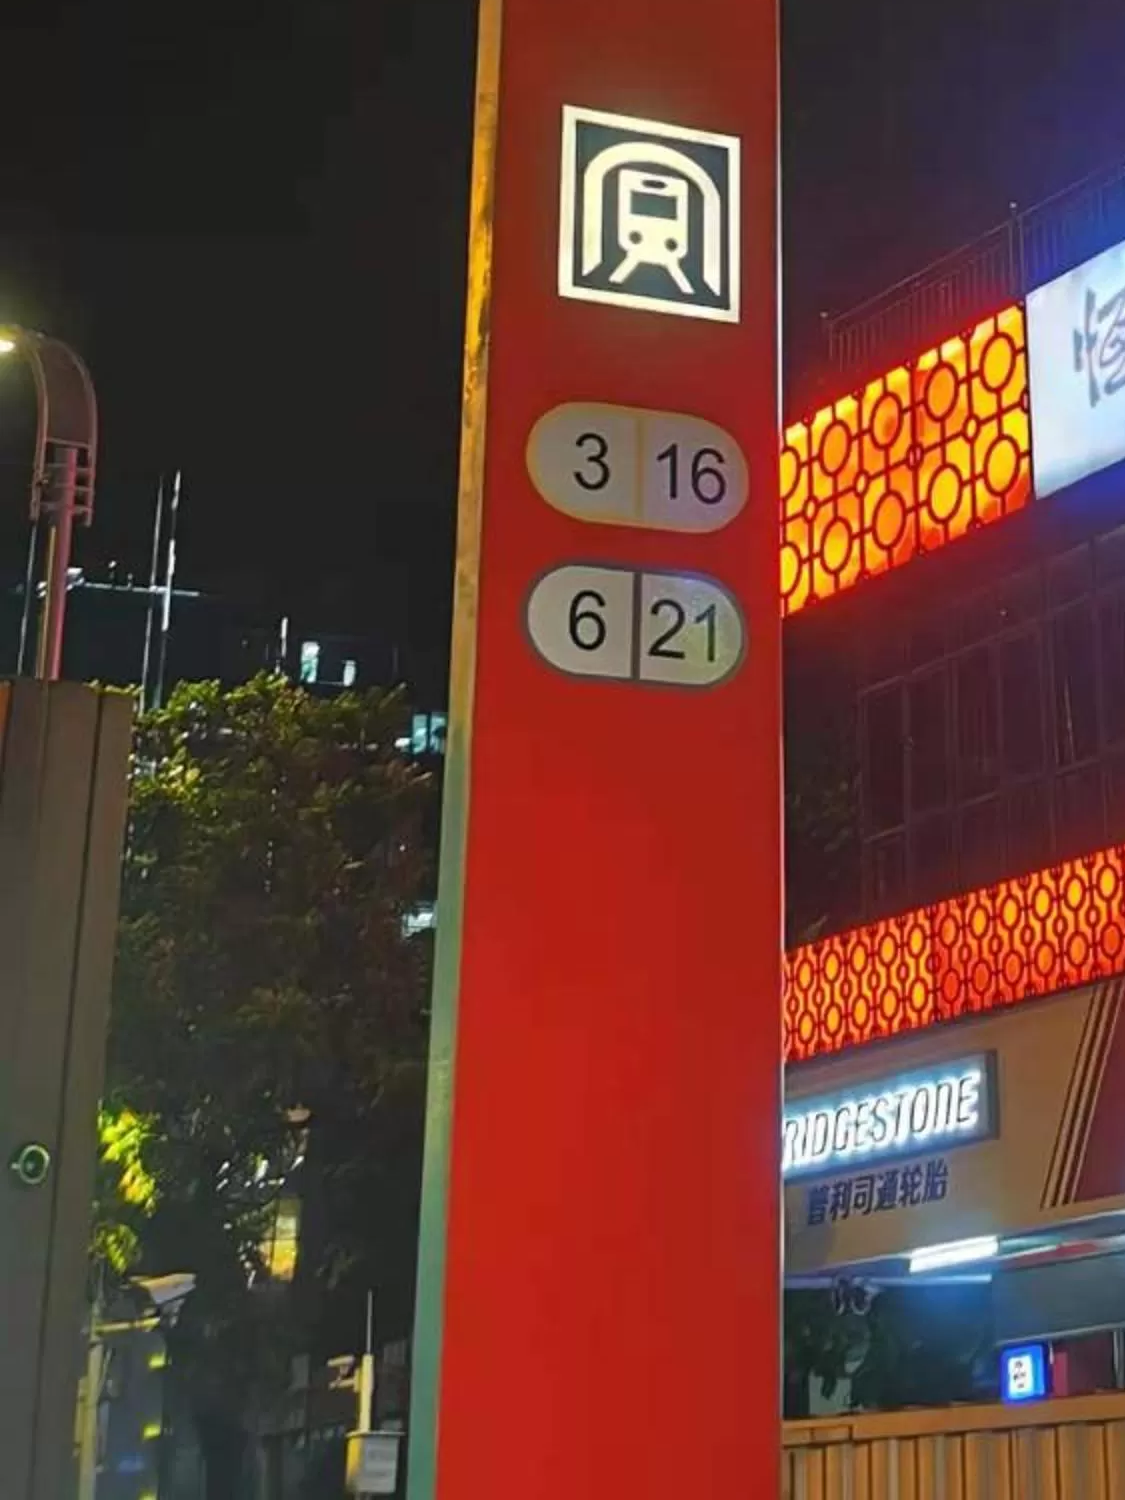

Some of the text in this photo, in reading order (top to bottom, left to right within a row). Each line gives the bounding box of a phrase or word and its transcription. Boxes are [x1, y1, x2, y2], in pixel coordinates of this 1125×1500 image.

[573, 432, 727, 505] 3 16
[568, 589, 717, 663] 6 21
[782, 1068, 982, 1169] RIDGESTONE
[807, 1158, 949, 1225] 普利司通轮胎
